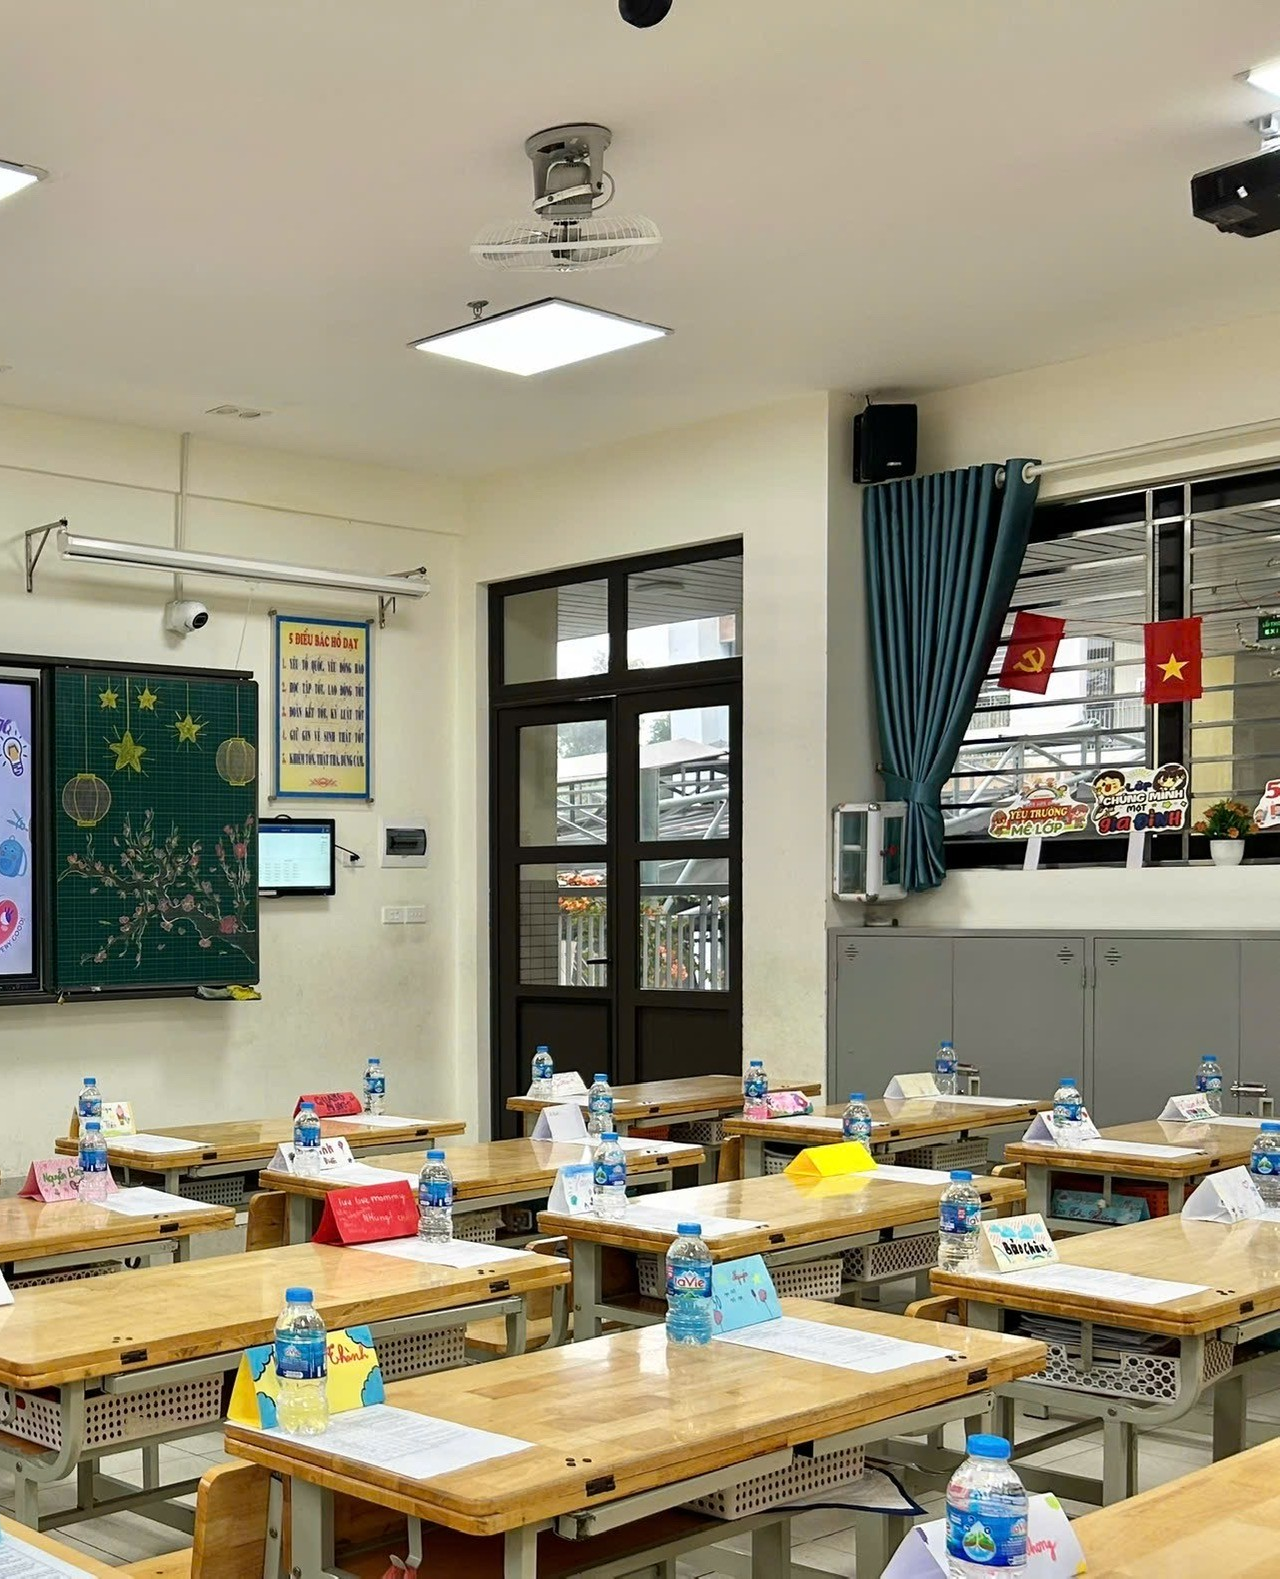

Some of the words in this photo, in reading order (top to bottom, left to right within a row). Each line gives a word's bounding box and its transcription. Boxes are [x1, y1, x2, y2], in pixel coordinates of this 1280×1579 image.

[289, 632, 294, 644] 5
[314, 631, 330, 647] BÁC
[342, 637, 359, 652] DẠY
[1103, 792, 1147, 806] CHÚNG
[1147, 788, 1185, 803] MÌNH
[1028, 804, 1068, 819] TRƯỜNG
[1125, 803, 1147, 814] MỘT
[1011, 820, 1032, 836] MÊ
[1034, 818, 1063, 835] LỚP
[1098, 815, 1131, 834] gia
[1133, 809, 1182, 831] ĐÌNH
[675, 1276, 706, 1288] laVie
[326, 1343, 368, 1365] Thành
[1026, 1539, 1057, 1562] hong
